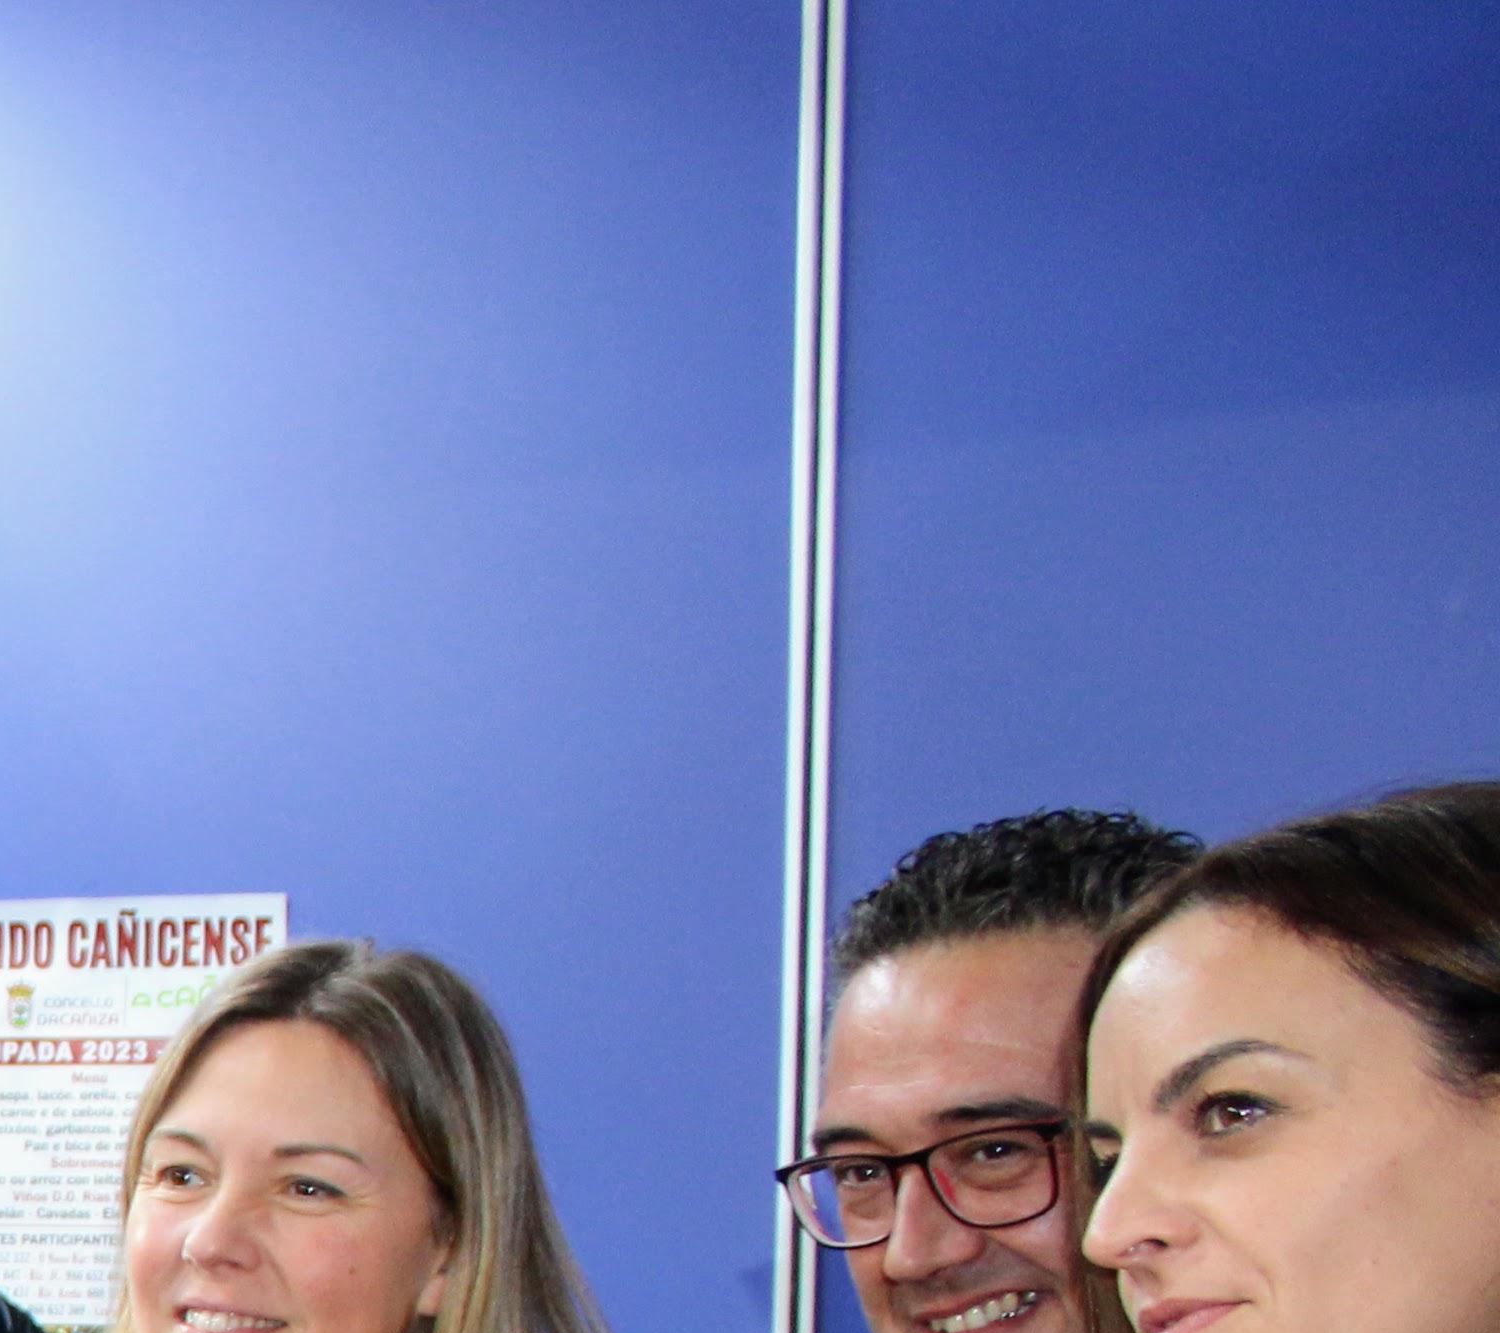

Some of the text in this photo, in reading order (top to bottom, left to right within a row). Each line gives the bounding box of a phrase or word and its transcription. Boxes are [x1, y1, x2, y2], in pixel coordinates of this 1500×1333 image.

[67, 907, 275, 970] CAÑICENSE
[130, 974, 218, 1010] A CAÑ
[81, 1039, 148, 1063] 2023
[36, 1206, 91, 1219] Cavadas
[21, 1232, 124, 1247] PARTICIPANTE
